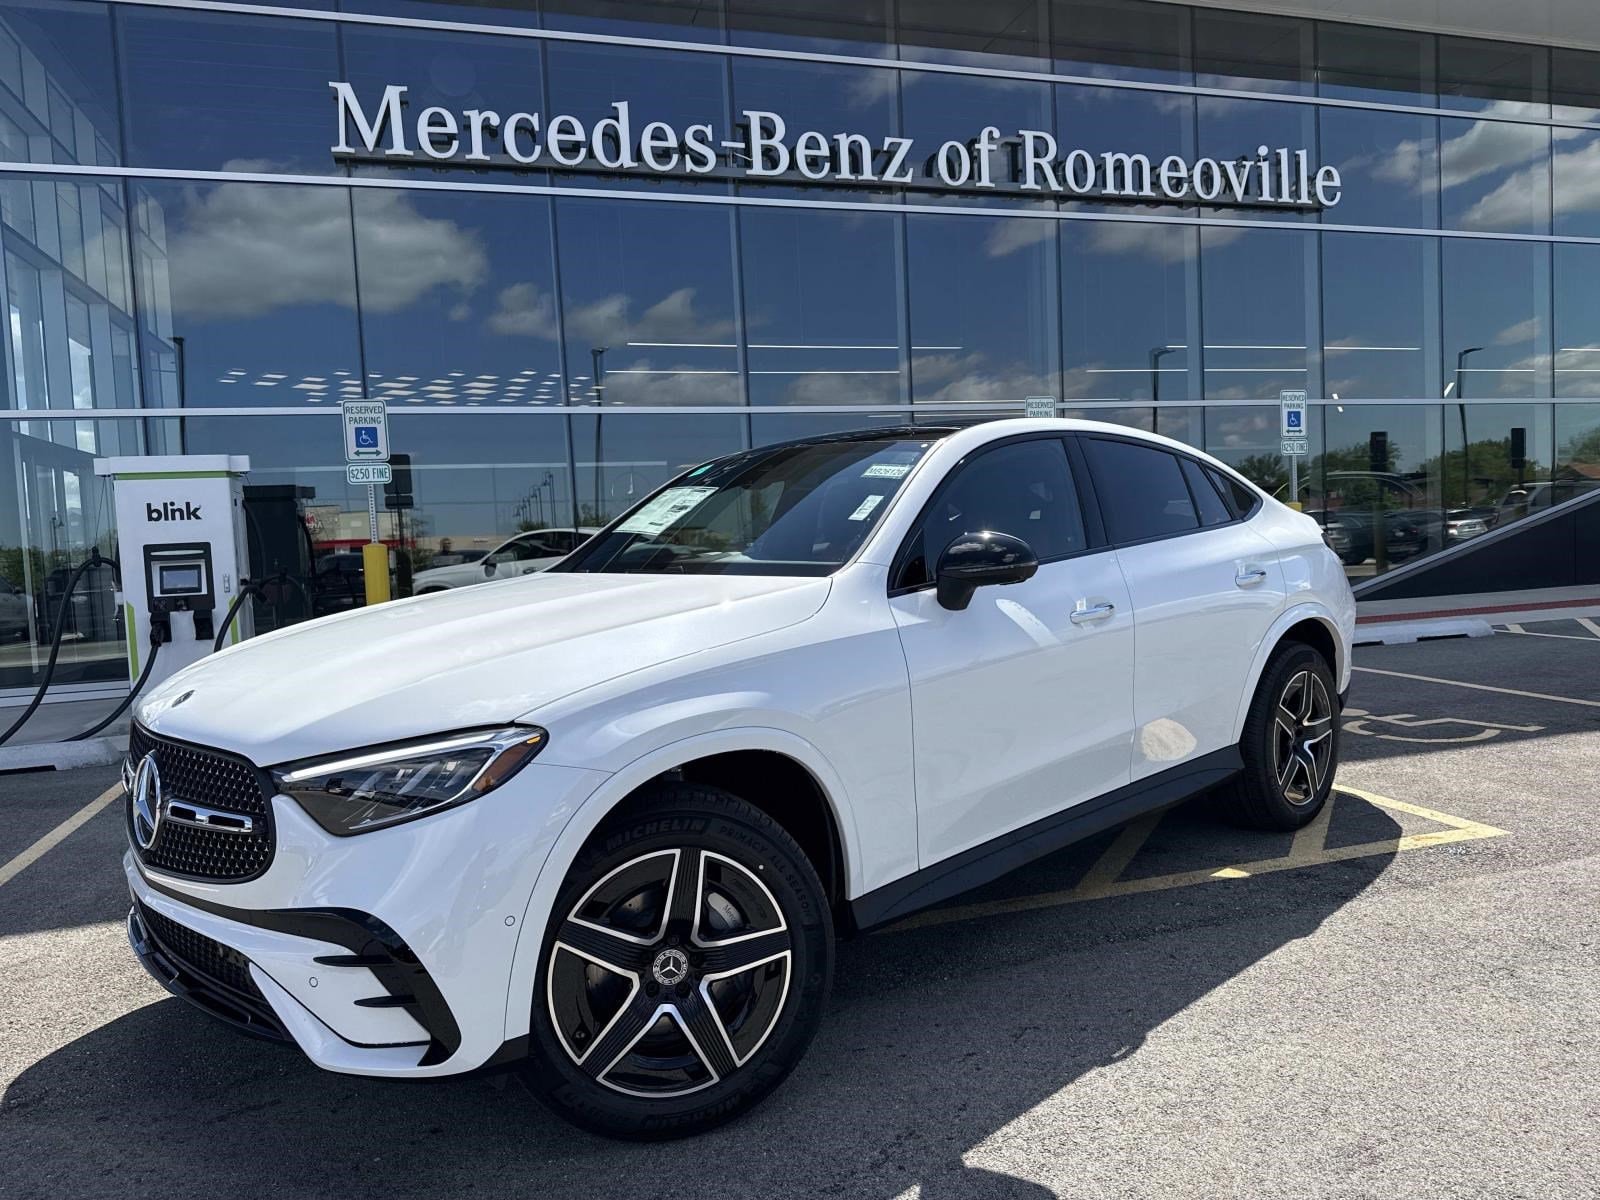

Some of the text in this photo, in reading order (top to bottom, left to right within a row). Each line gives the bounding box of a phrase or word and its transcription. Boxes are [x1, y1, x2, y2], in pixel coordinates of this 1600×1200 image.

[328, 80, 1342, 206] Mercedes-Benz of Romeoville
[345, 406, 383, 414] RESERVED
[348, 416, 382, 425] PARKING
[350, 467, 389, 480] $250 FINE
[146, 501, 203, 522] blink
[606, 819, 706, 852] MICHELIN
[719, 825, 770, 853] PRIMACY
[770, 854, 786, 874] ALL
